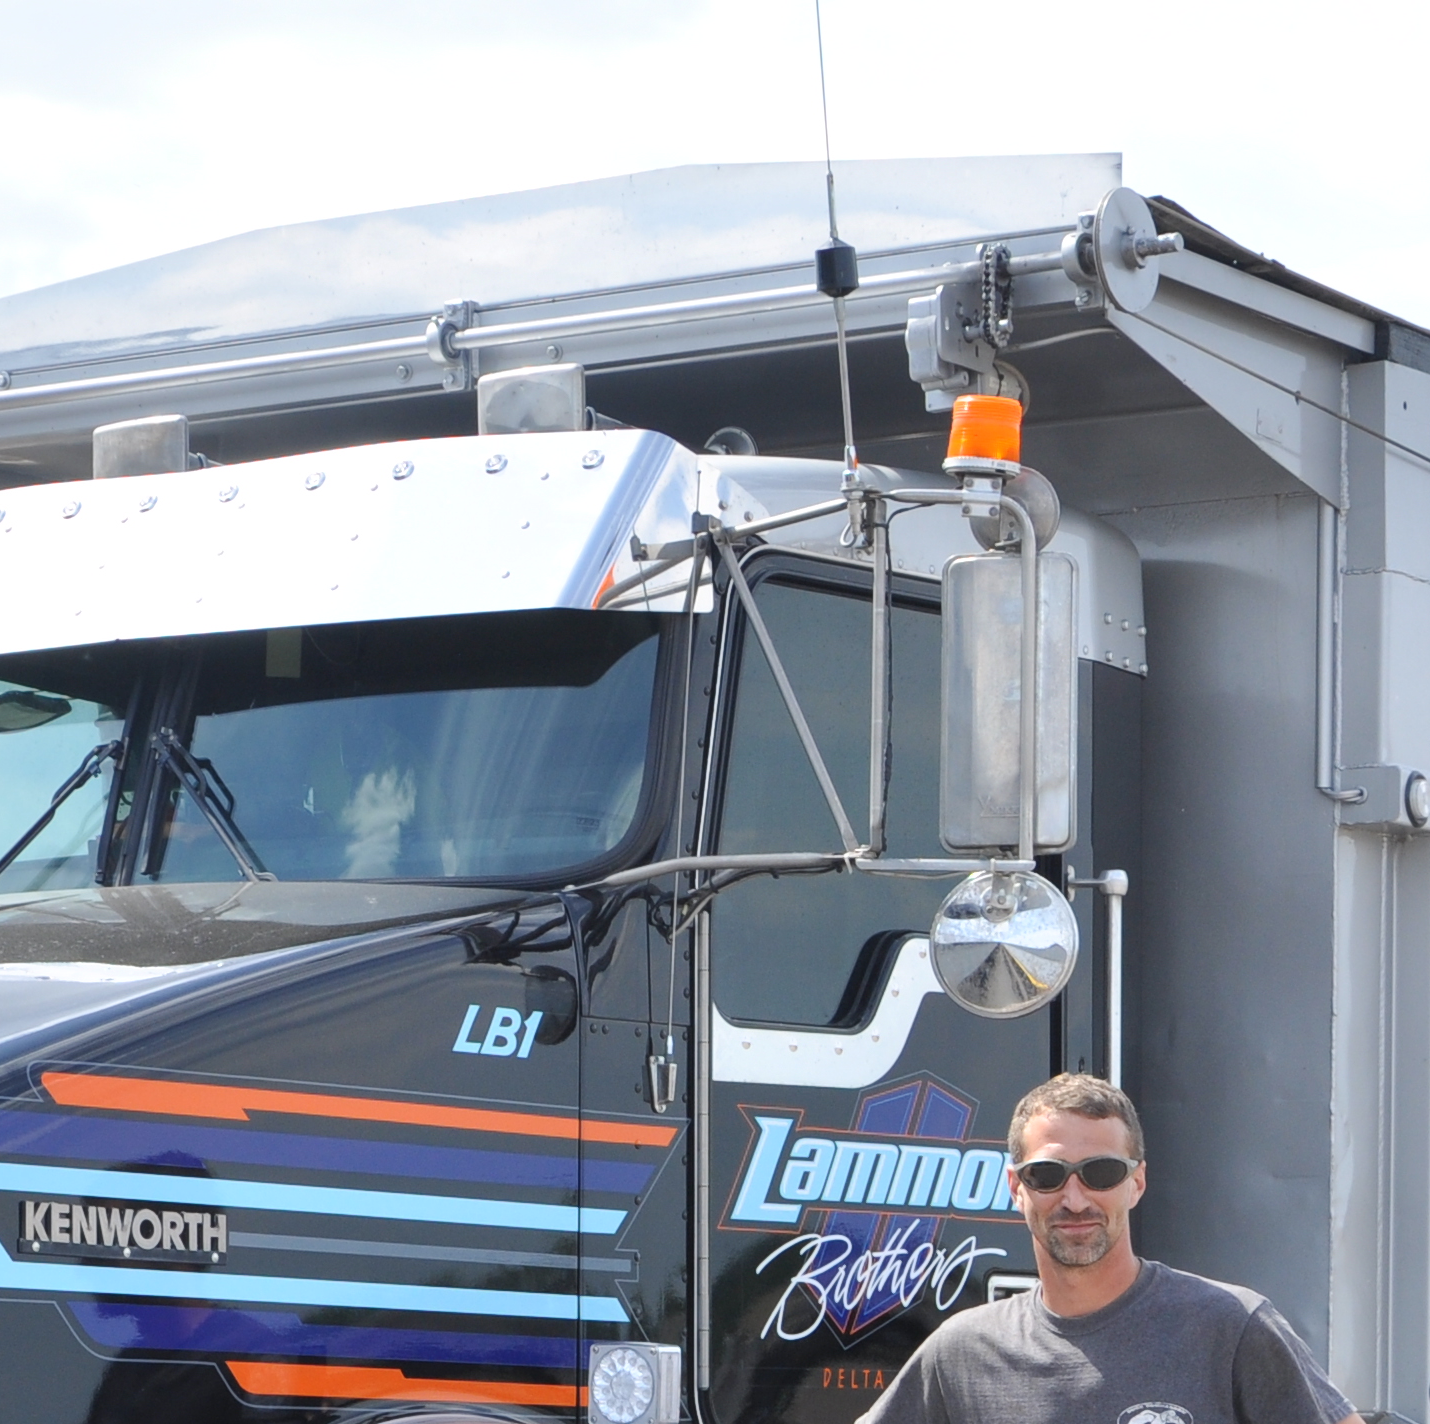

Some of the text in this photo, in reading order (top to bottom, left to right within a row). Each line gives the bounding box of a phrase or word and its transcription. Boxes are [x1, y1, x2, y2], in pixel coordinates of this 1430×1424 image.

[452, 1004, 543, 1059] LB1
[25, 1200, 227, 1253] KENWORTH
[756, 1219, 1007, 1340] Brothers
[823, 1367, 884, 1389] DELTA
